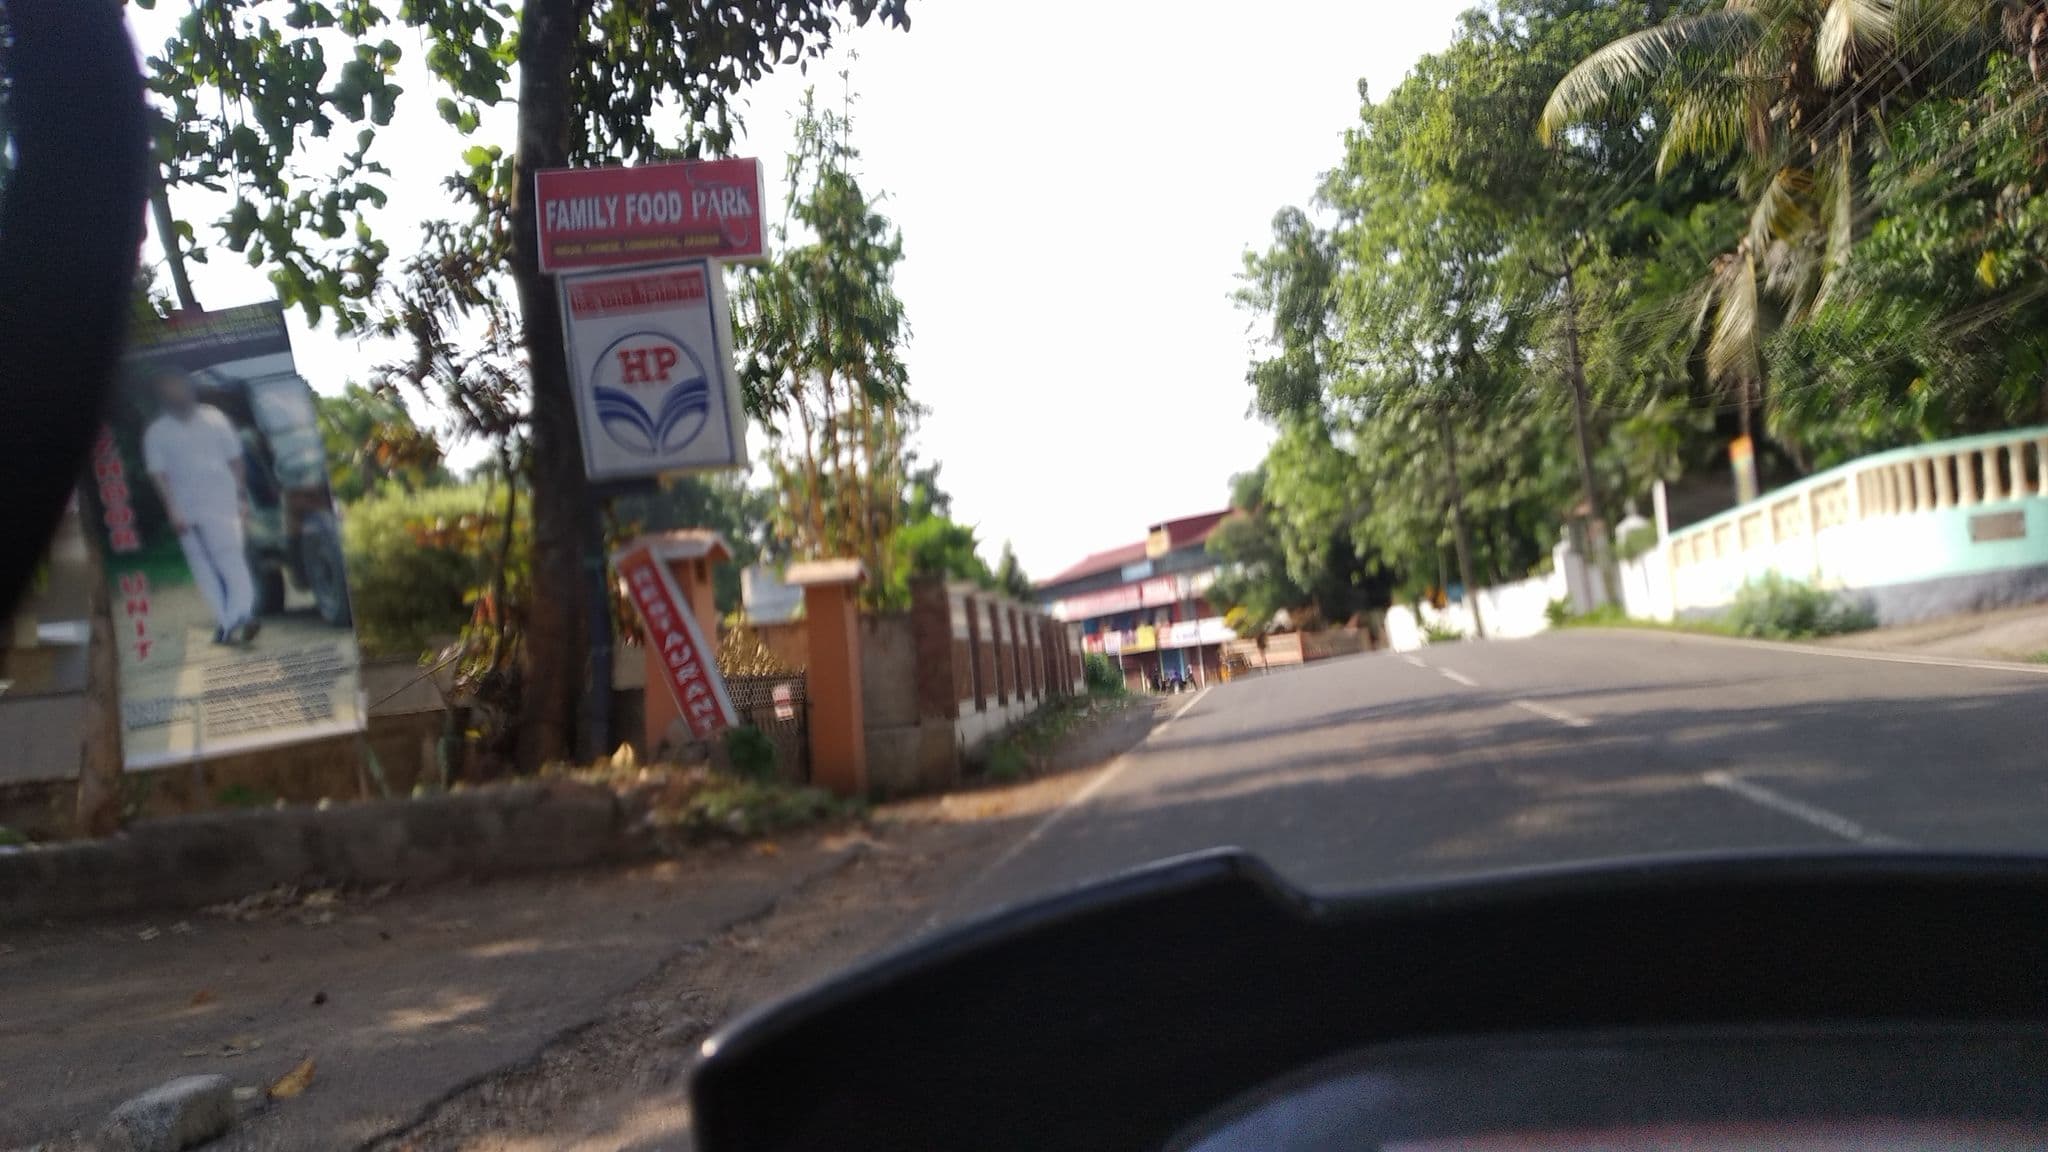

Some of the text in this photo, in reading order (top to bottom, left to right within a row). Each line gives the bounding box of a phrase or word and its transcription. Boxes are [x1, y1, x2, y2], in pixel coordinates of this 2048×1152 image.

[545, 185, 753, 232] FAMILY FOOD PARK
[617, 345, 679, 385] HP
[119, 569, 154, 662] UNIT
